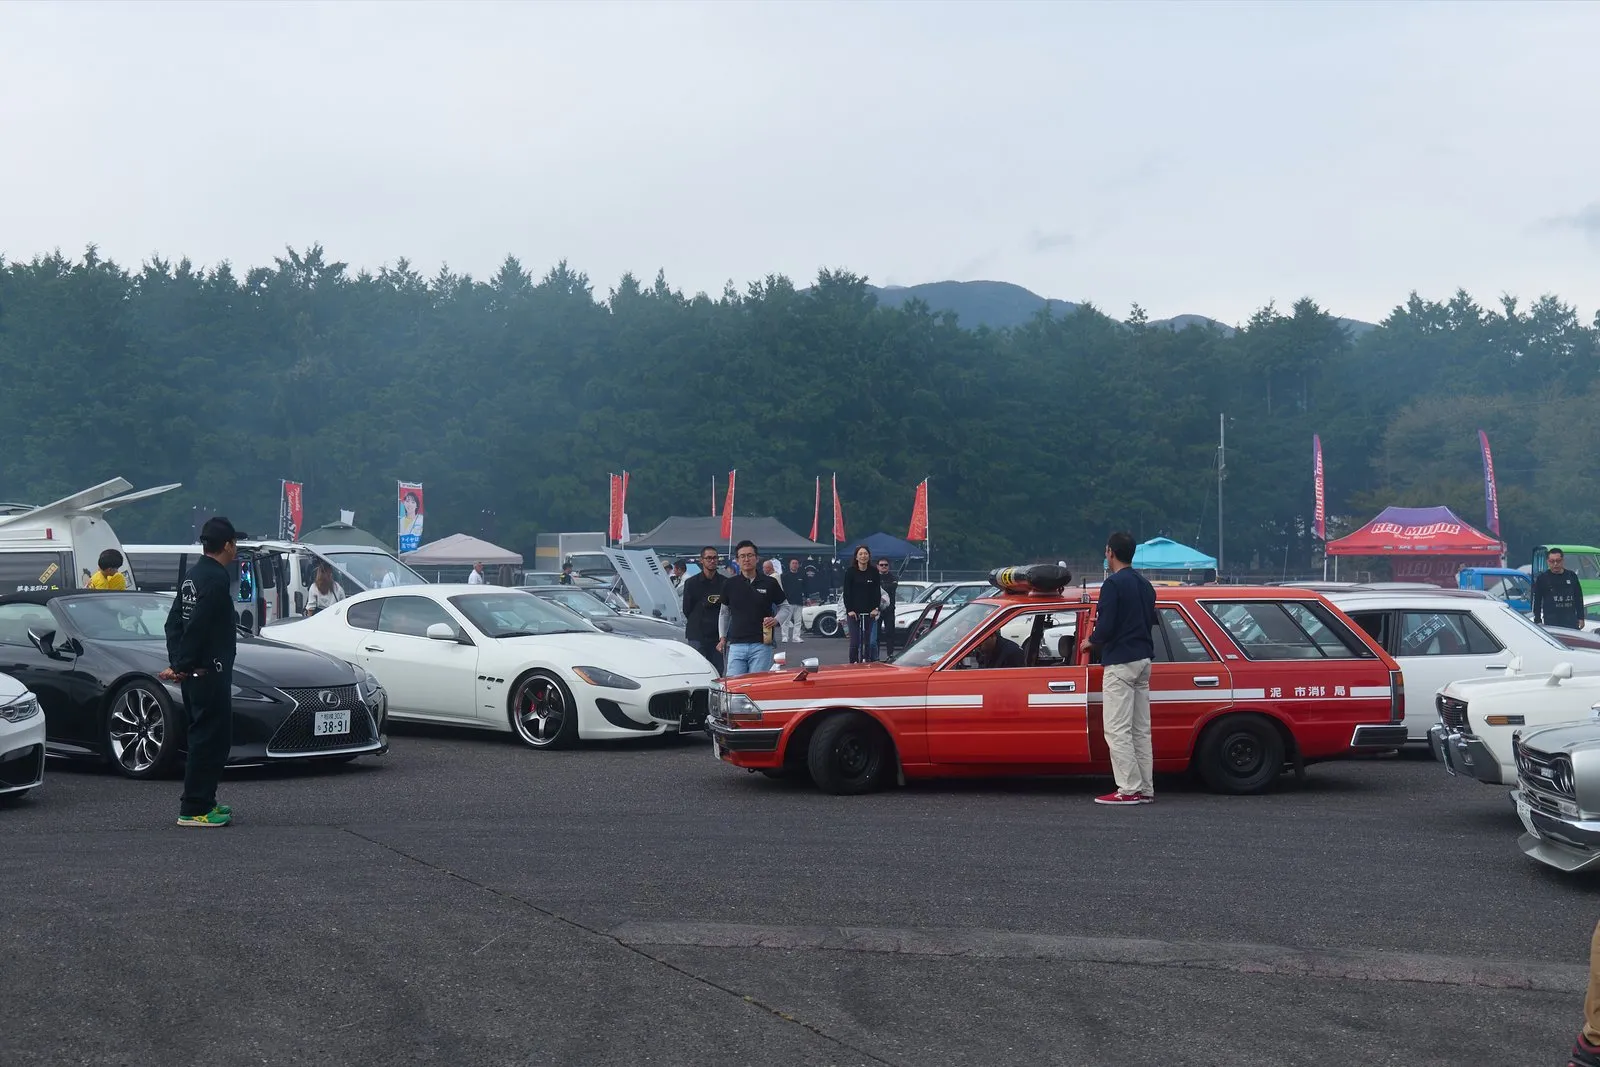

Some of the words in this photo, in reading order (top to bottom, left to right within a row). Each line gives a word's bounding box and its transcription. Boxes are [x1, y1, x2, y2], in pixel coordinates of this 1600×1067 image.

[1371, 522, 1403, 534] RED
[1404, 522, 1460, 535] MOTOR
[322, 720, 348, 733] 38-91
